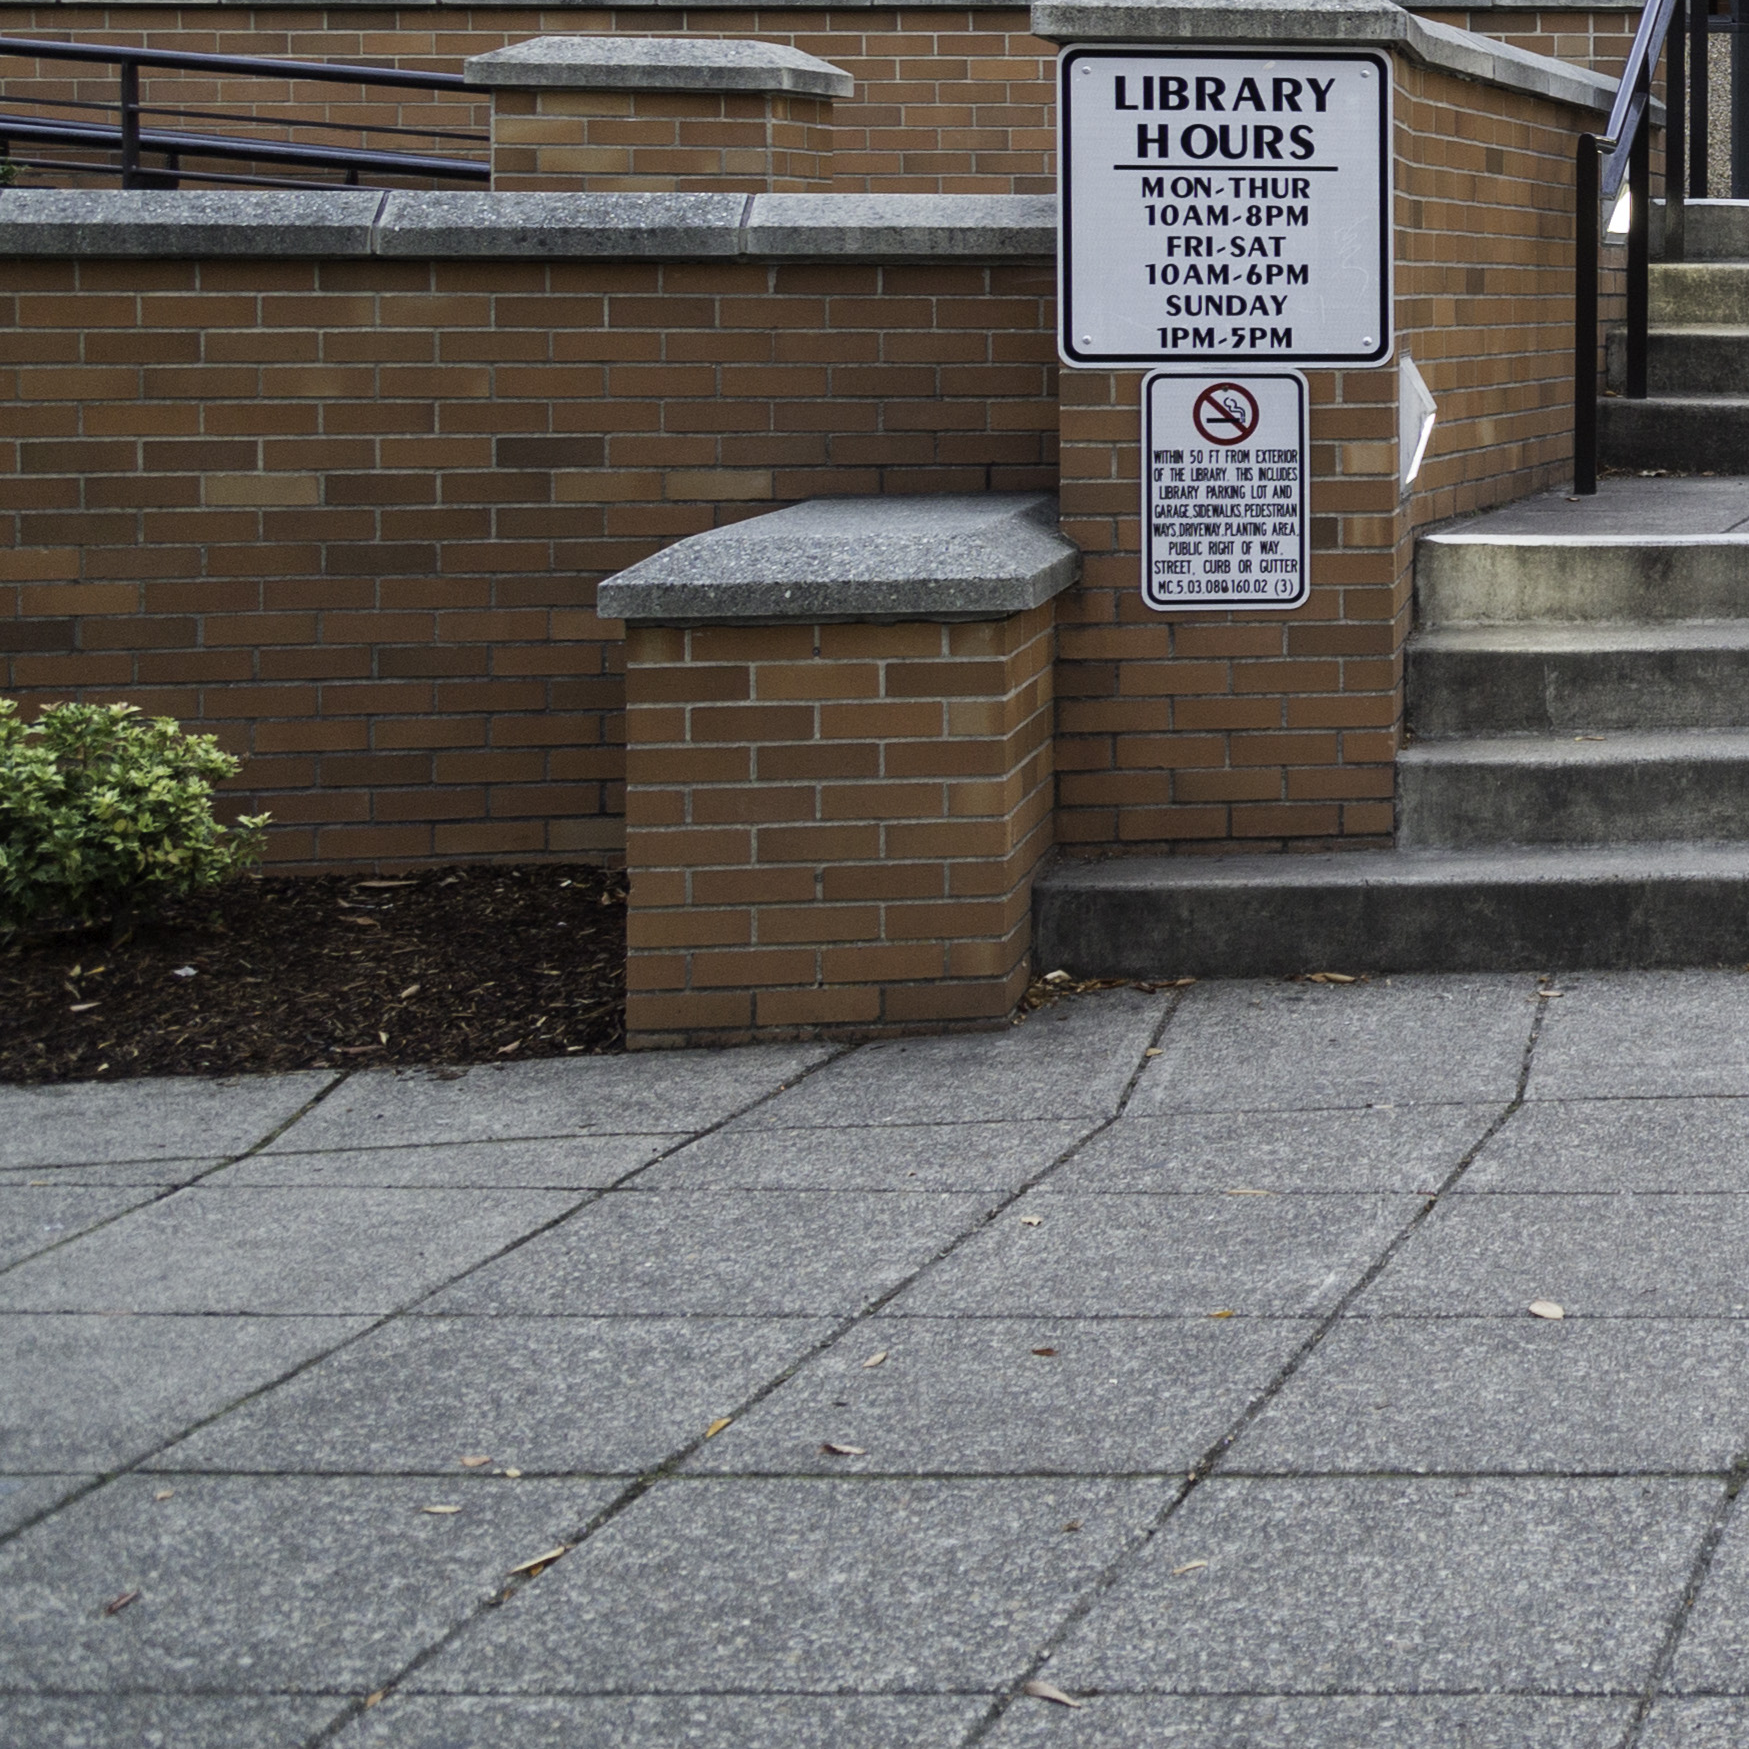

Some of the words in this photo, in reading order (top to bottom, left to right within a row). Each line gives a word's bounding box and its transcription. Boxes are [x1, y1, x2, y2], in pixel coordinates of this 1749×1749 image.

[1114, 75, 1336, 113] LIBRARY
[1137, 123, 1315, 161] HOURS
[1141, 176, 1311, 200] MON-THUR
[1144, 204, 1309, 227] 10AM-8PM
[1167, 235, 1287, 258] FRI-SAT
[1145, 263, 1309, 286] 10AM-6PM
[1166, 294, 1288, 317] SUNDAY
[1156, 327, 1293, 349] 1PM-5PM
[1153, 449, 1184, 464] WITHIN
[1190, 449, 1204, 464] 50
[1208, 449, 1220, 464] FT
[1225, 449, 1250, 464] FROM
[1255, 449, 1298, 464] EXTERIOR
[1153, 467, 1165, 482] OF
[1170, 467, 1186, 482] THE
[1235, 467, 1253, 482] THIS
[1258, 467, 1298, 482] INCLUDES
[1159, 485, 1199, 500] LIBRARY
[1206, 485, 1246, 500] PARKING
[1251, 485, 1268, 500] LOT
[1272, 485, 1293, 500] AND
[1168, 540, 1203, 556] PUBLIC
[1208, 540, 1235, 556] RIGHT
[1241, 540, 1254, 556] OF
[1203, 559, 1231, 576] CURB
[1238, 559, 1253, 576] OR
[1259, 559, 1298, 576] GUTTER
[1274, 579, 1294, 596] (3)
